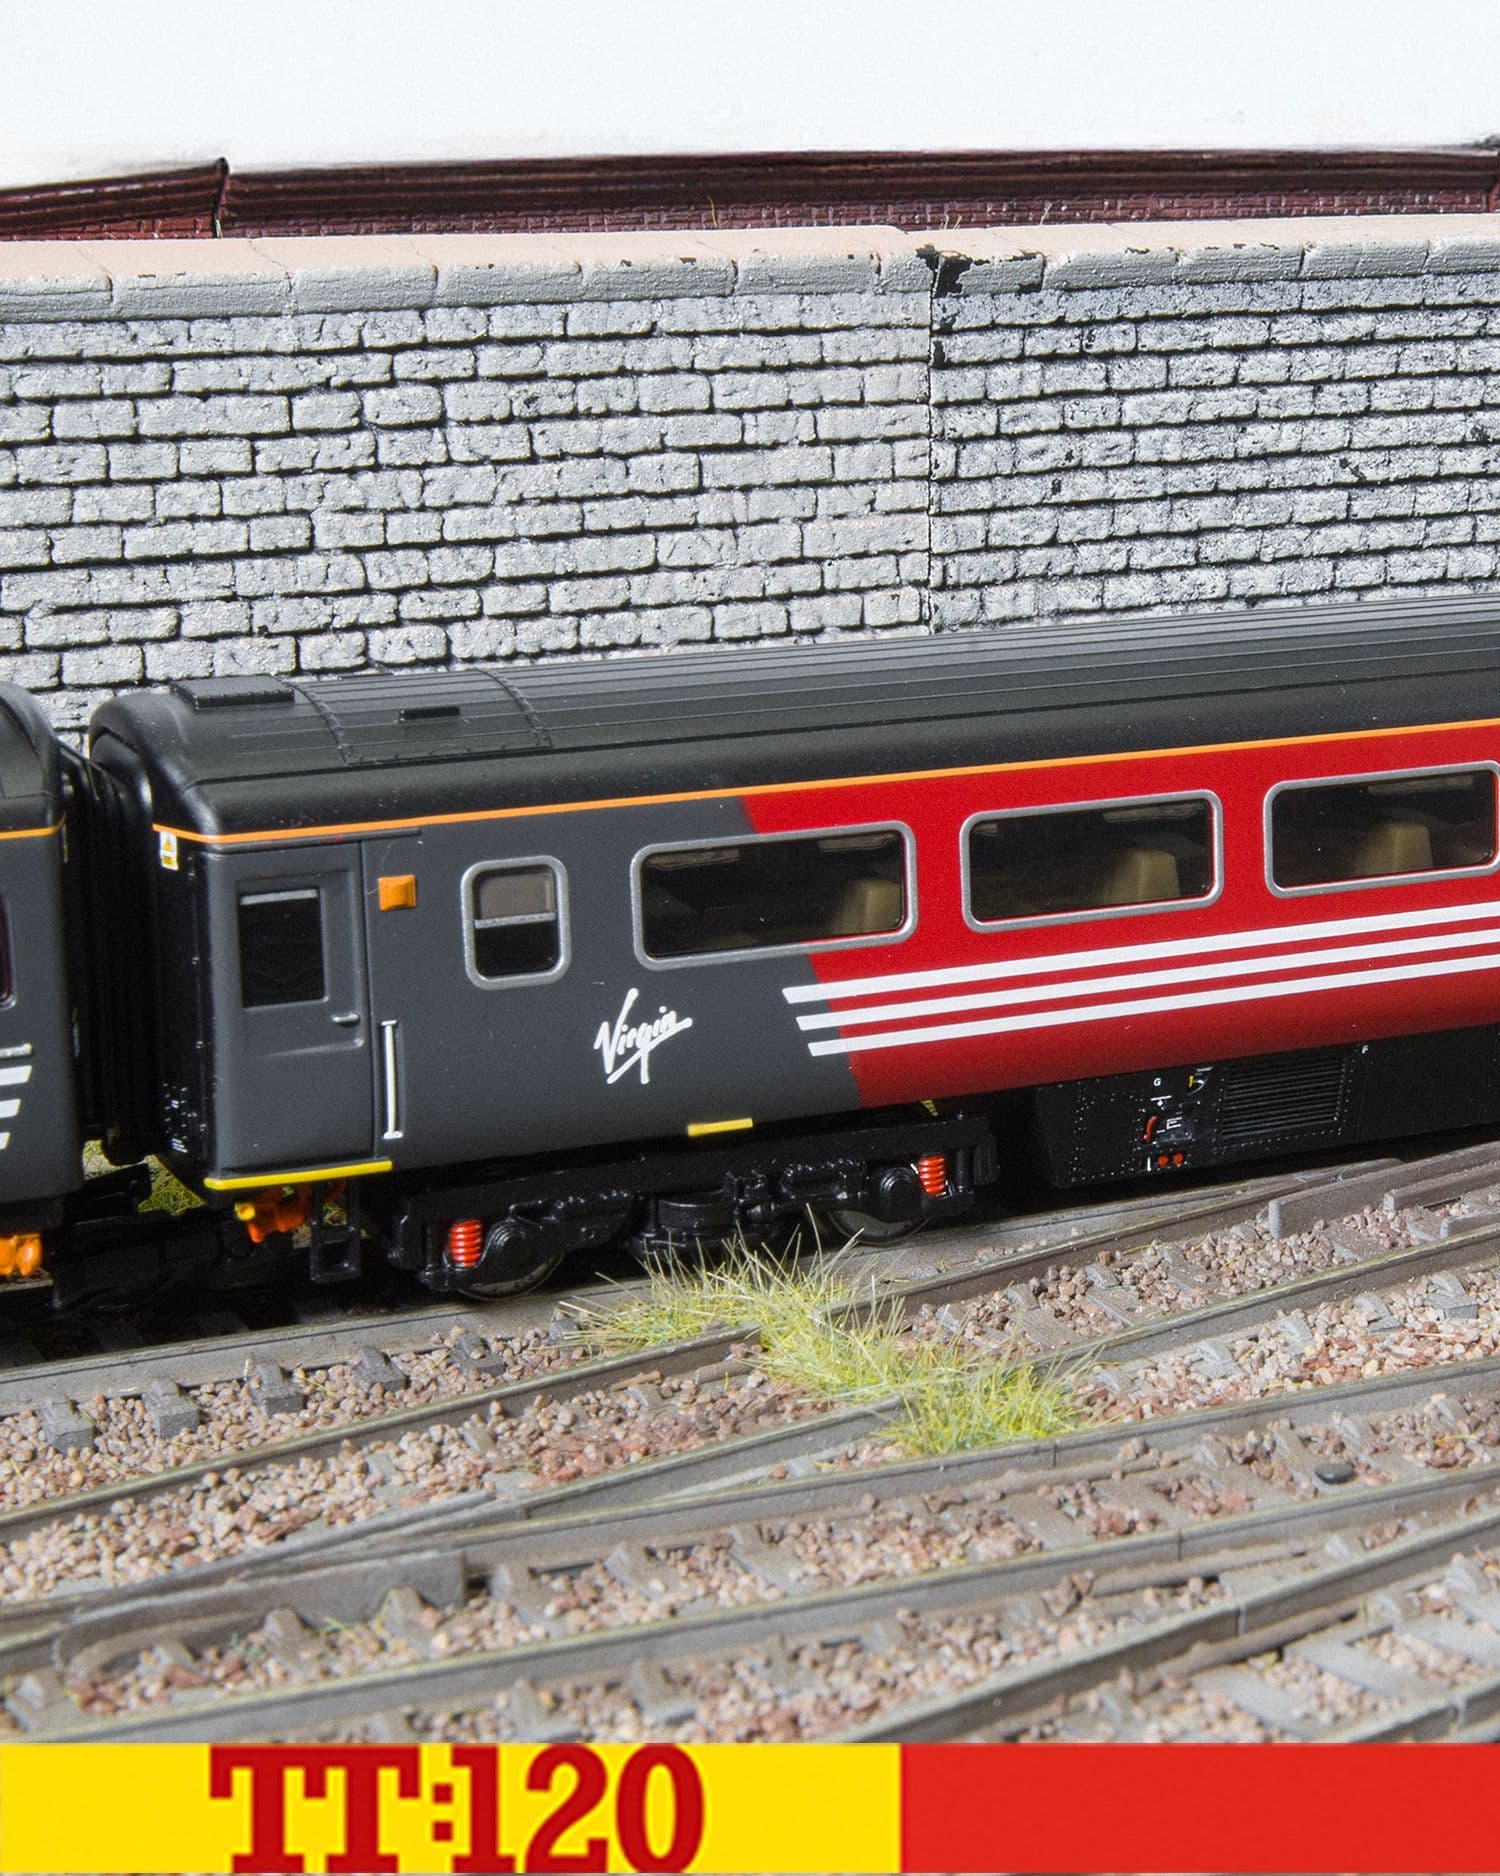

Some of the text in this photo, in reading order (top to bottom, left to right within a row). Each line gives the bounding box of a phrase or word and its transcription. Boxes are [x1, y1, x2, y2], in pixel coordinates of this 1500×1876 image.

[593, 988, 693, 1084] Virgin
[1361, 1045, 1369, 1054] F
[1153, 1077, 1162, 1087] G
